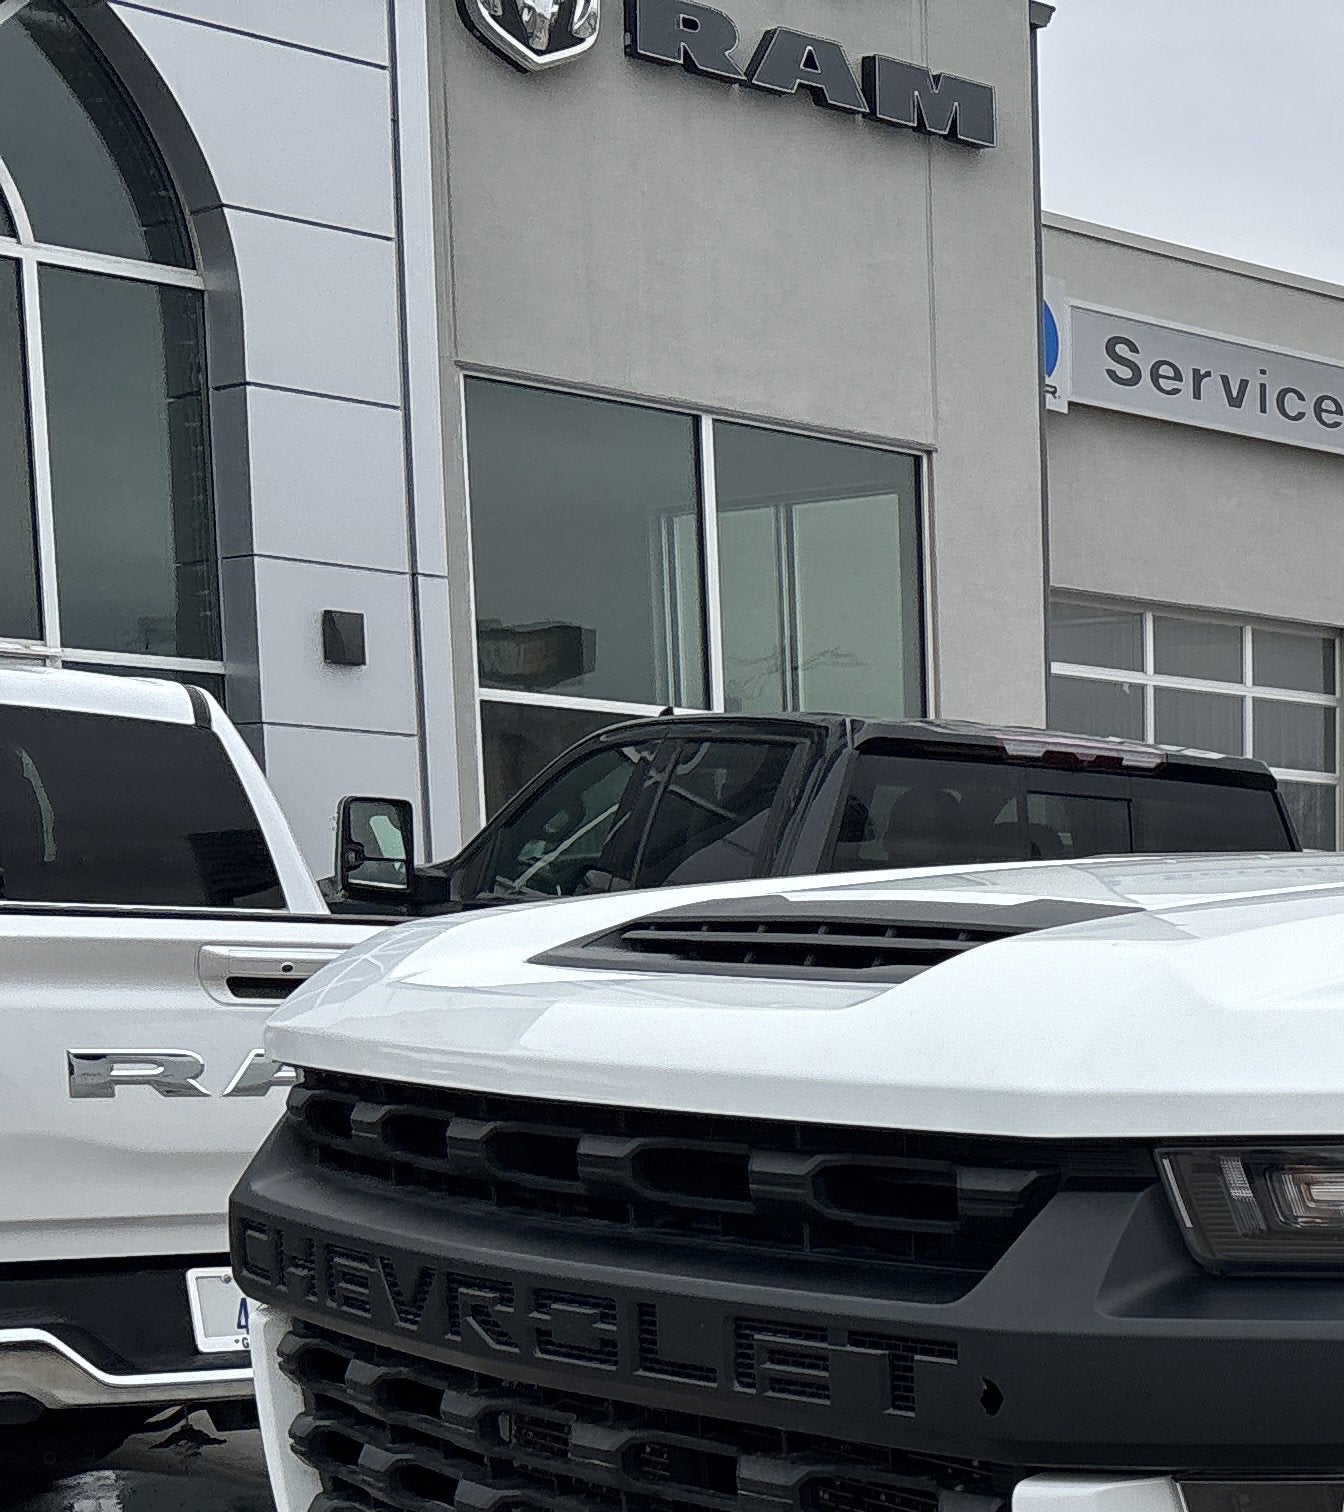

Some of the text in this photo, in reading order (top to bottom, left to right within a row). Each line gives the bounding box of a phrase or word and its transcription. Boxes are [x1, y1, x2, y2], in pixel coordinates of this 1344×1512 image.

[627, 0, 996, 148] RAM
[1103, 334, 1344, 430] Service
[240, 1218, 959, 1417] CHEVROLET
